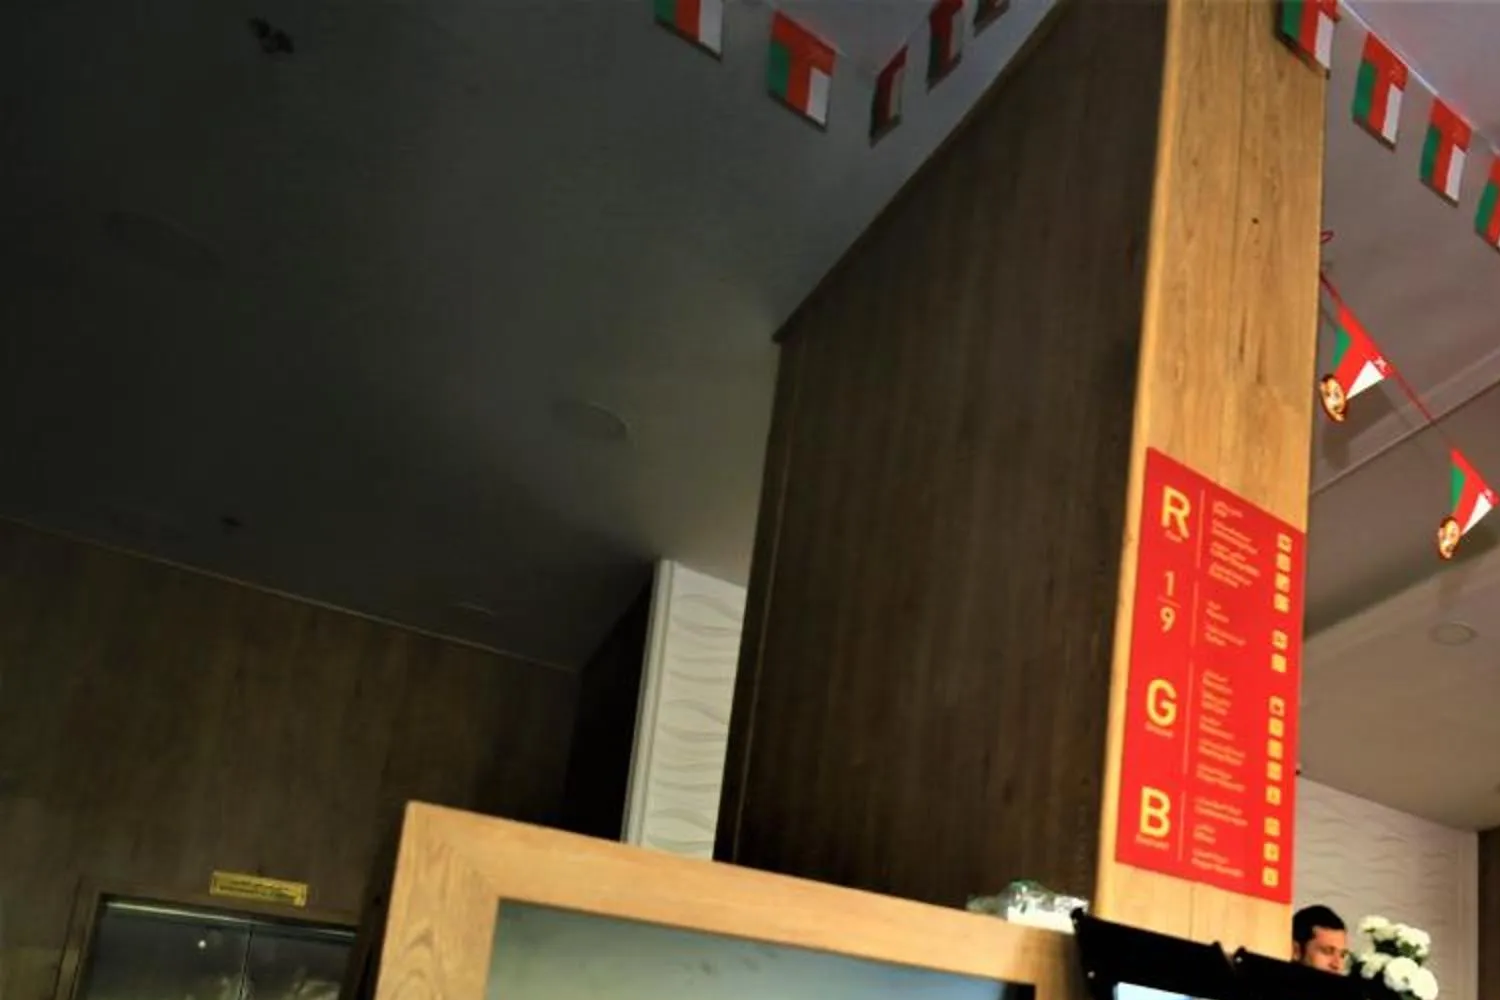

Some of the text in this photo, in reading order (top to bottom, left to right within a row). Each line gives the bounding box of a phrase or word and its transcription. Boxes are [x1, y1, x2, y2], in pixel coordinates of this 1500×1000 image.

[1161, 485, 1190, 539] R
[1164, 570, 1175, 597] 1
[1160, 606, 1176, 633] 9
[1147, 678, 1177, 727] G
[1140, 786, 1171, 838] B
